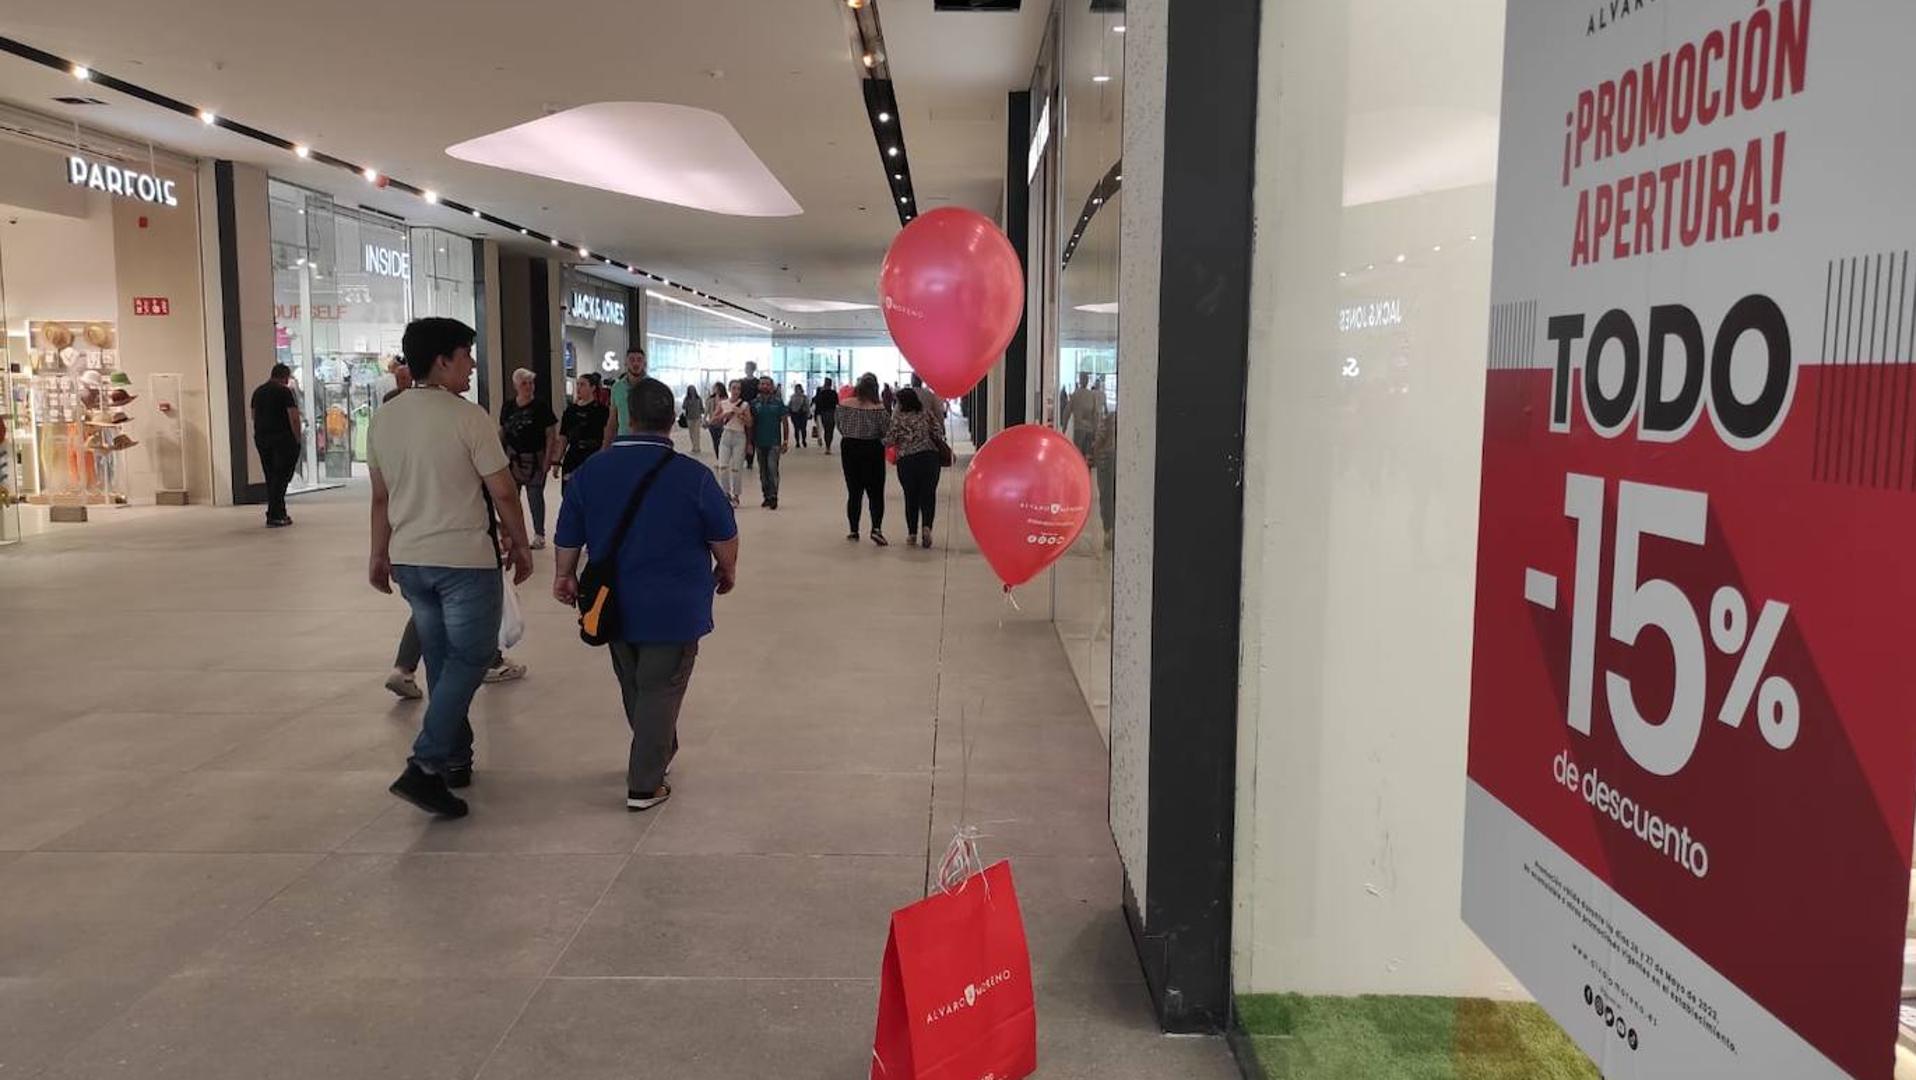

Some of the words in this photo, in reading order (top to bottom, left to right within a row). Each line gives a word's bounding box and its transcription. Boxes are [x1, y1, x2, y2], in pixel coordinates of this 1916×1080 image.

[1585, 0, 1655, 37] ALVA
[1562, 0, 1812, 187] ¡PROMOCIÓN
[67, 156, 178, 207] PARFOIS
[1570, 130, 1787, 268] APERTURA!
[365, 244, 411, 279] INSIDE
[572, 292, 625, 326] JACK&JONES
[1547, 292, 1793, 440] TODO
[1523, 471, 1801, 776] -15%
[1553, 750, 1578, 792] de
[1582, 765, 1710, 878] descuento
[926, 997, 965, 1024] ALVARO
[976, 970, 1010, 995] MORENO
[1655, 963, 1664, 976] de
[1665, 970, 1686, 994] Mayo
[1687, 990, 1697, 1004] de
